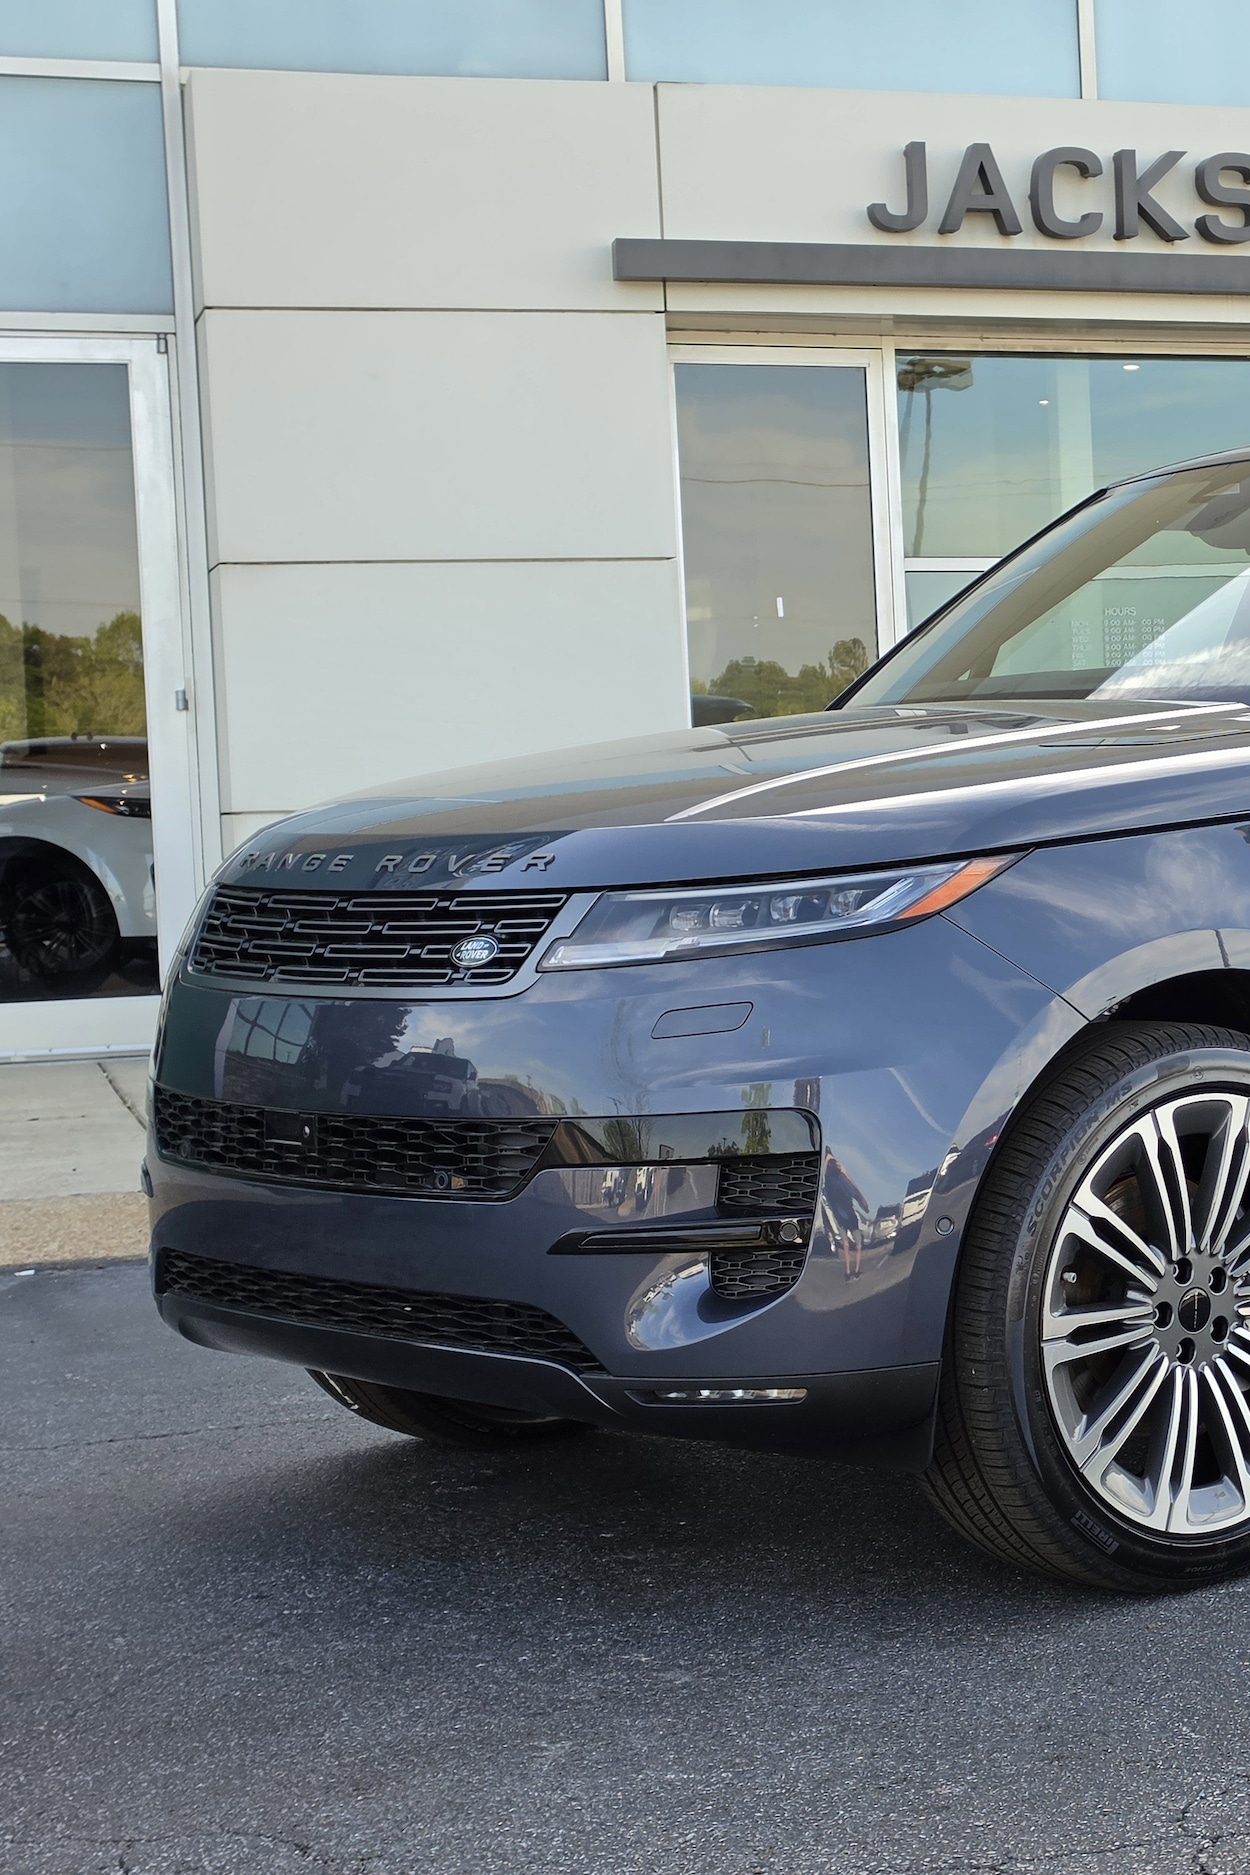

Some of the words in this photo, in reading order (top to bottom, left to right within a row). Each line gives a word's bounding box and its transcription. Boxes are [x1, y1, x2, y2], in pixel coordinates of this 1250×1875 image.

[1104, 606, 1137, 616] HOURS
[237, 851, 354, 873] RANGE
[375, 852, 556, 874] ROVER
[460, 940, 485, 951] LAND
[459, 949, 489, 960] ROVER
[1026, 1111, 1101, 1238] SCORPION
[1070, 1510, 1120, 1556] PIRELLI
